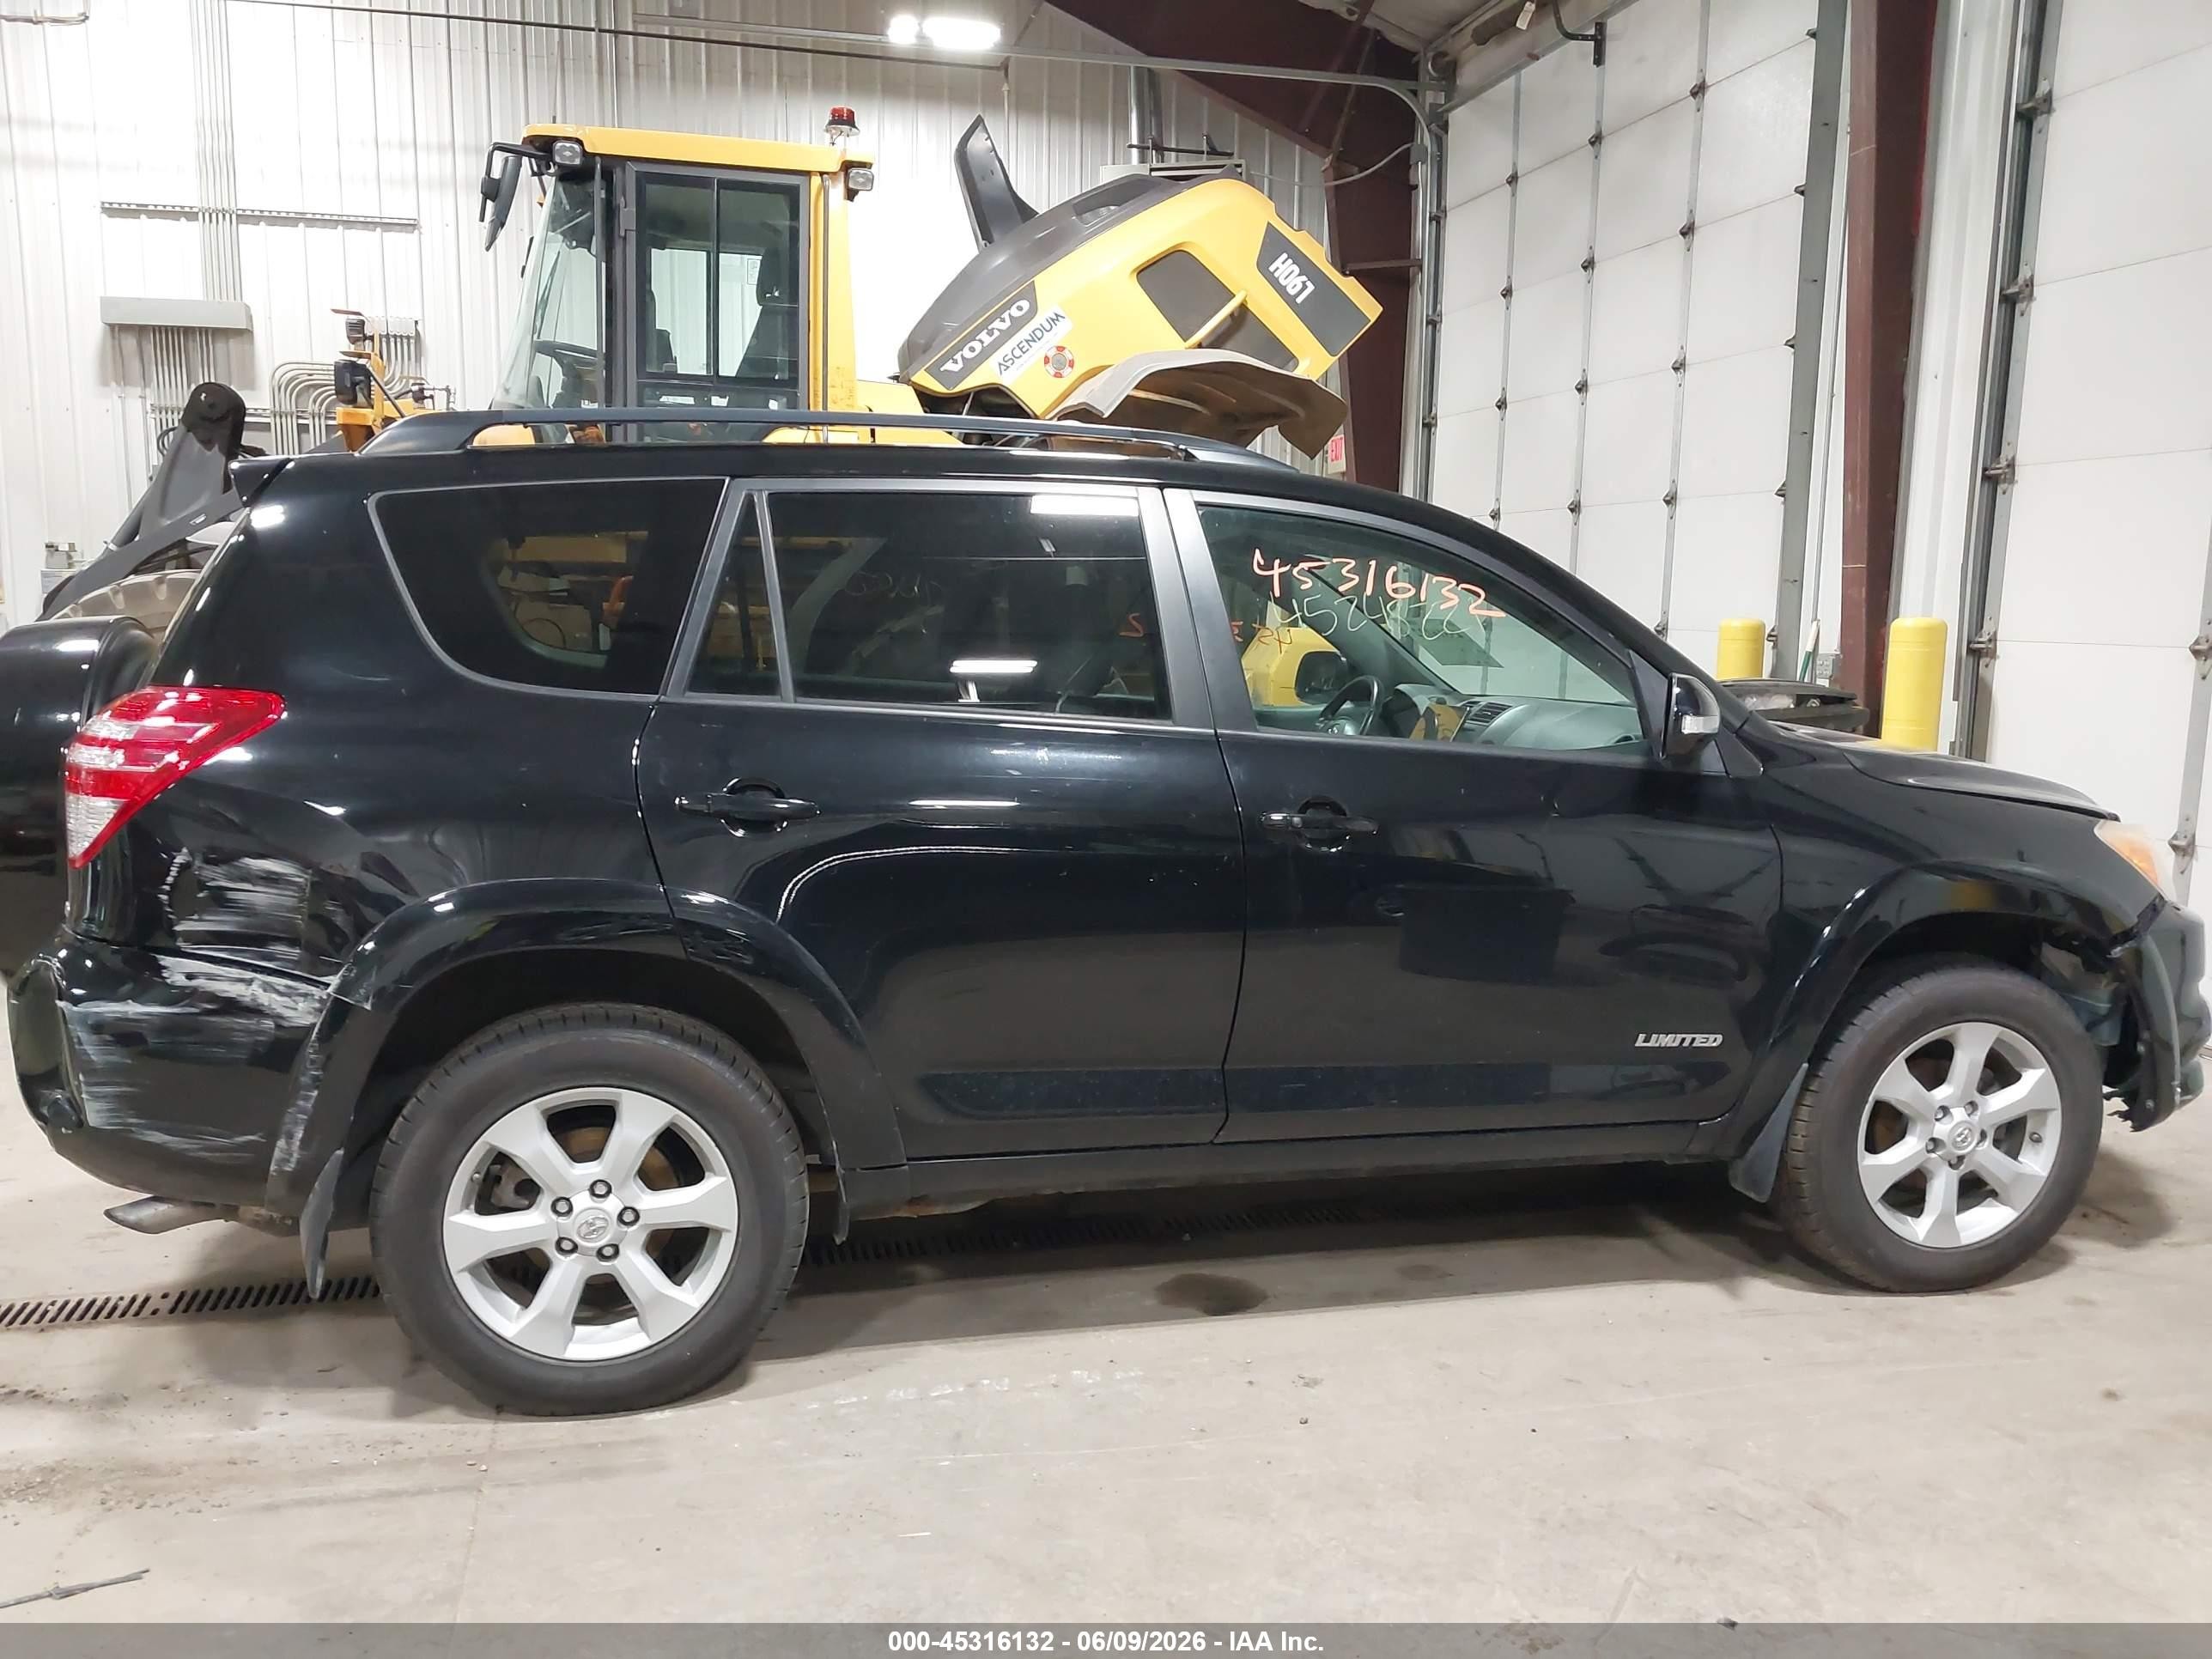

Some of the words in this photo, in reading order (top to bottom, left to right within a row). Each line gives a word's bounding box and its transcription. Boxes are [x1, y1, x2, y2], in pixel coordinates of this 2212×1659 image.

[939, 299, 1030, 373] VOLVO
[997, 312, 1066, 376] ASCENDUM
[1330, 436, 1344, 463] EXIT
[1251, 547, 1507, 617] 45316132
[1634, 1033, 1723, 1048] LIMITED
